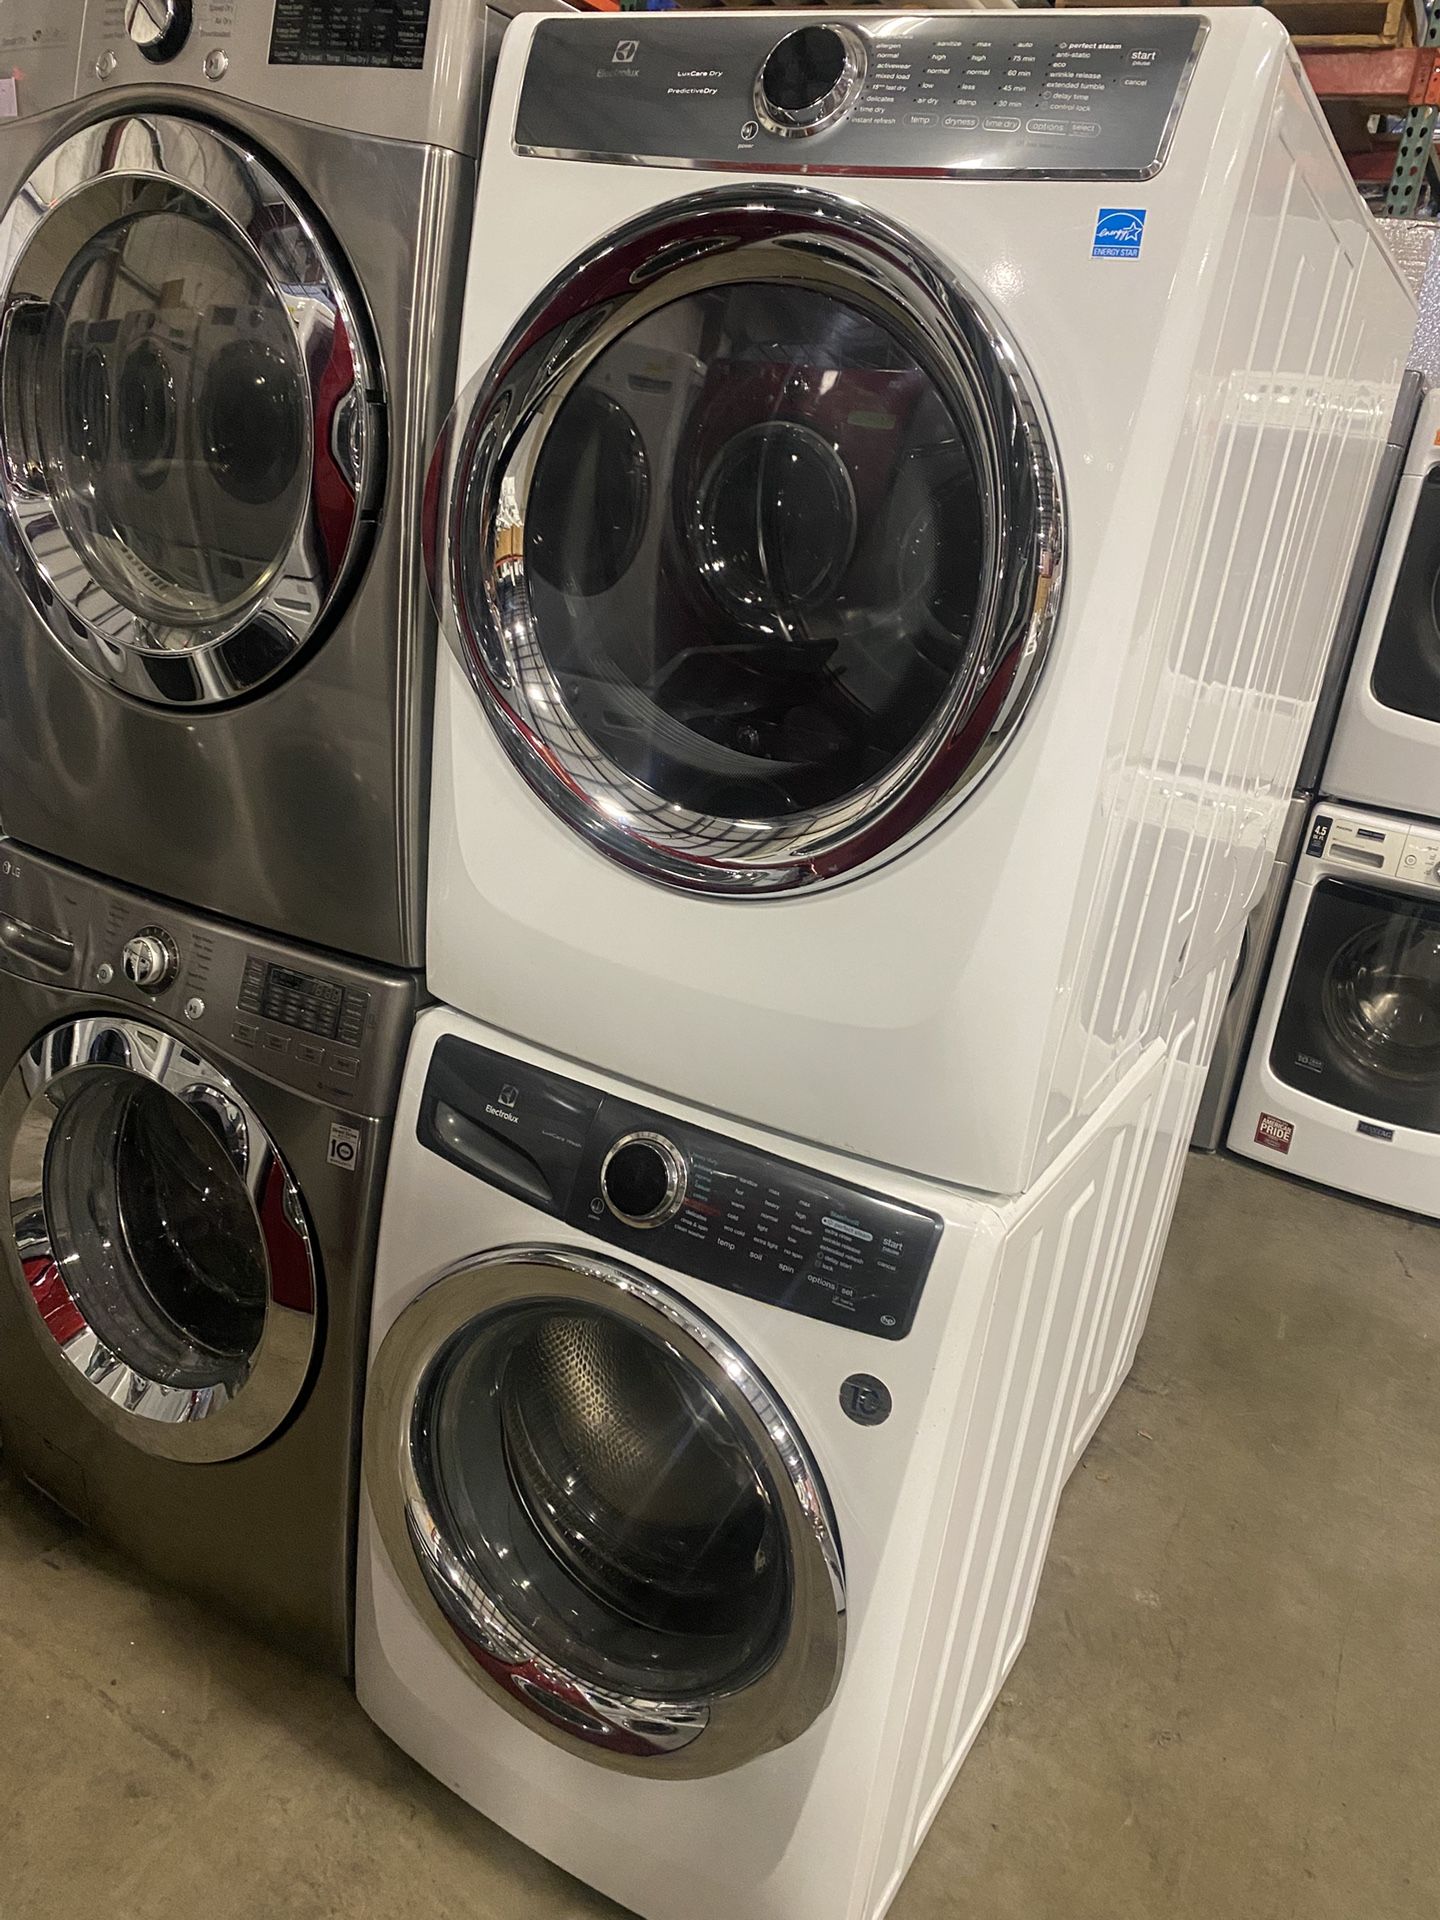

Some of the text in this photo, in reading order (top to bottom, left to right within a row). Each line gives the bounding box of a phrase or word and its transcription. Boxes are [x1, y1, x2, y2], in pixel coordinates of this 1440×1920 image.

[1068, 42, 1097, 50] perfect
[931, 53, 947, 61] high
[1131, 51, 1157, 61] start
[667, 87, 718, 95] PredictiveDry
[944, 117, 976, 127] dryness
[1093, 248, 1138, 257] ENERGY STAR
[485, 1104, 520, 1124] Electrolux
[1260, 1123, 1290, 1142] PRIDE
[717, 1237, 736, 1251] temp
[882, 1237, 904, 1252] start
[749, 1251, 763, 1261] soil
[778, 1262, 795, 1274] spin
[807, 1273, 837, 1292] options
[841, 1288, 854, 1298] set
